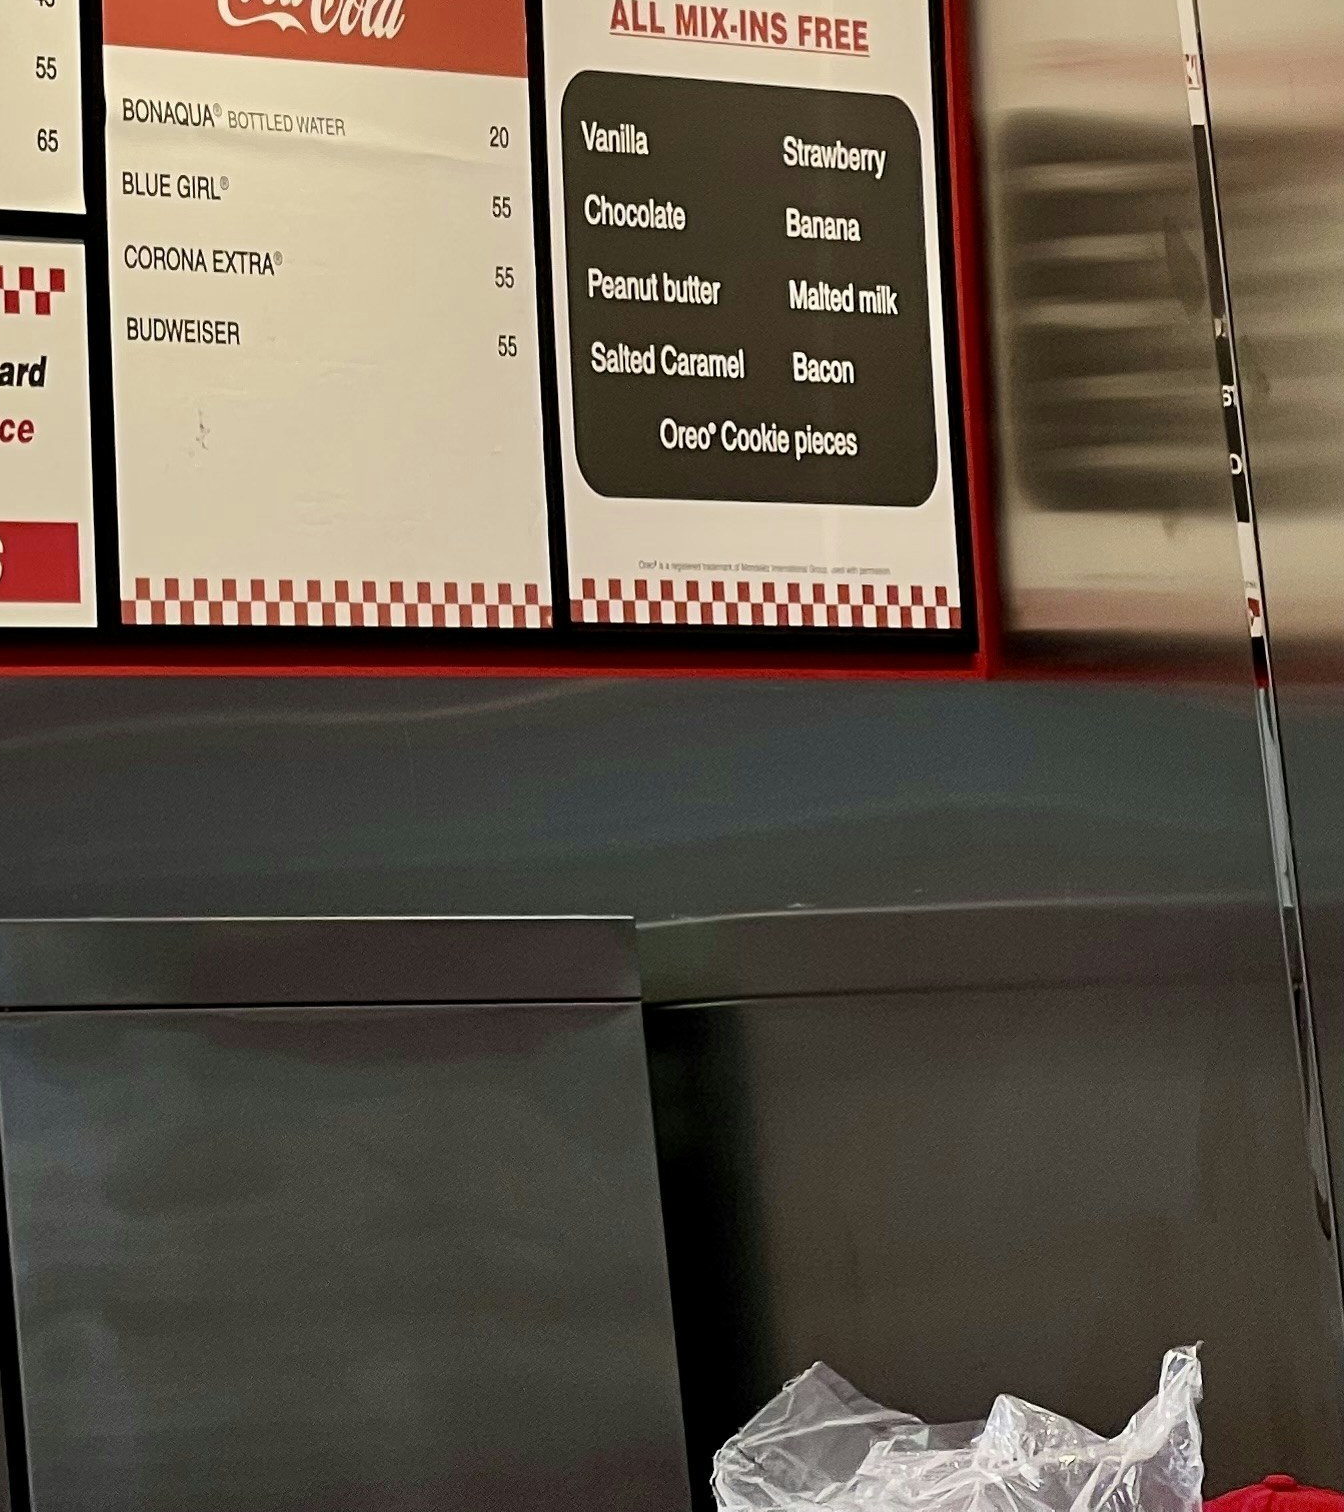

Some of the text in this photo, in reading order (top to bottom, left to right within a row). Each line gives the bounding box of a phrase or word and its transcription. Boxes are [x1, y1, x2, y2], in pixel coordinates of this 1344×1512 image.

[675, 4, 787, 44] MIX-INS
[798, 15, 868, 52] FREE
[36, 56, 56, 79] 55
[228, 111, 292, 132] BOTTLED
[296, 117, 345, 136] WATER
[490, 126, 508, 148] 20
[581, 121, 648, 154] Vanilla
[38, 129, 58, 152] 65
[783, 136, 886, 179] Strawberry
[123, 172, 171, 197] BLUE
[493, 196, 511, 218] 55
[585, 194, 685, 230] Chocolate
[786, 208, 860, 241] Banana
[588, 268, 720, 304] Peanut butter
[789, 280, 898, 314] Malted milk
[127, 317, 240, 345] BUDWEISER
[499, 335, 517, 356] 55
[592, 342, 744, 378] Salted Caramel
[793, 352, 854, 383] Bacon
